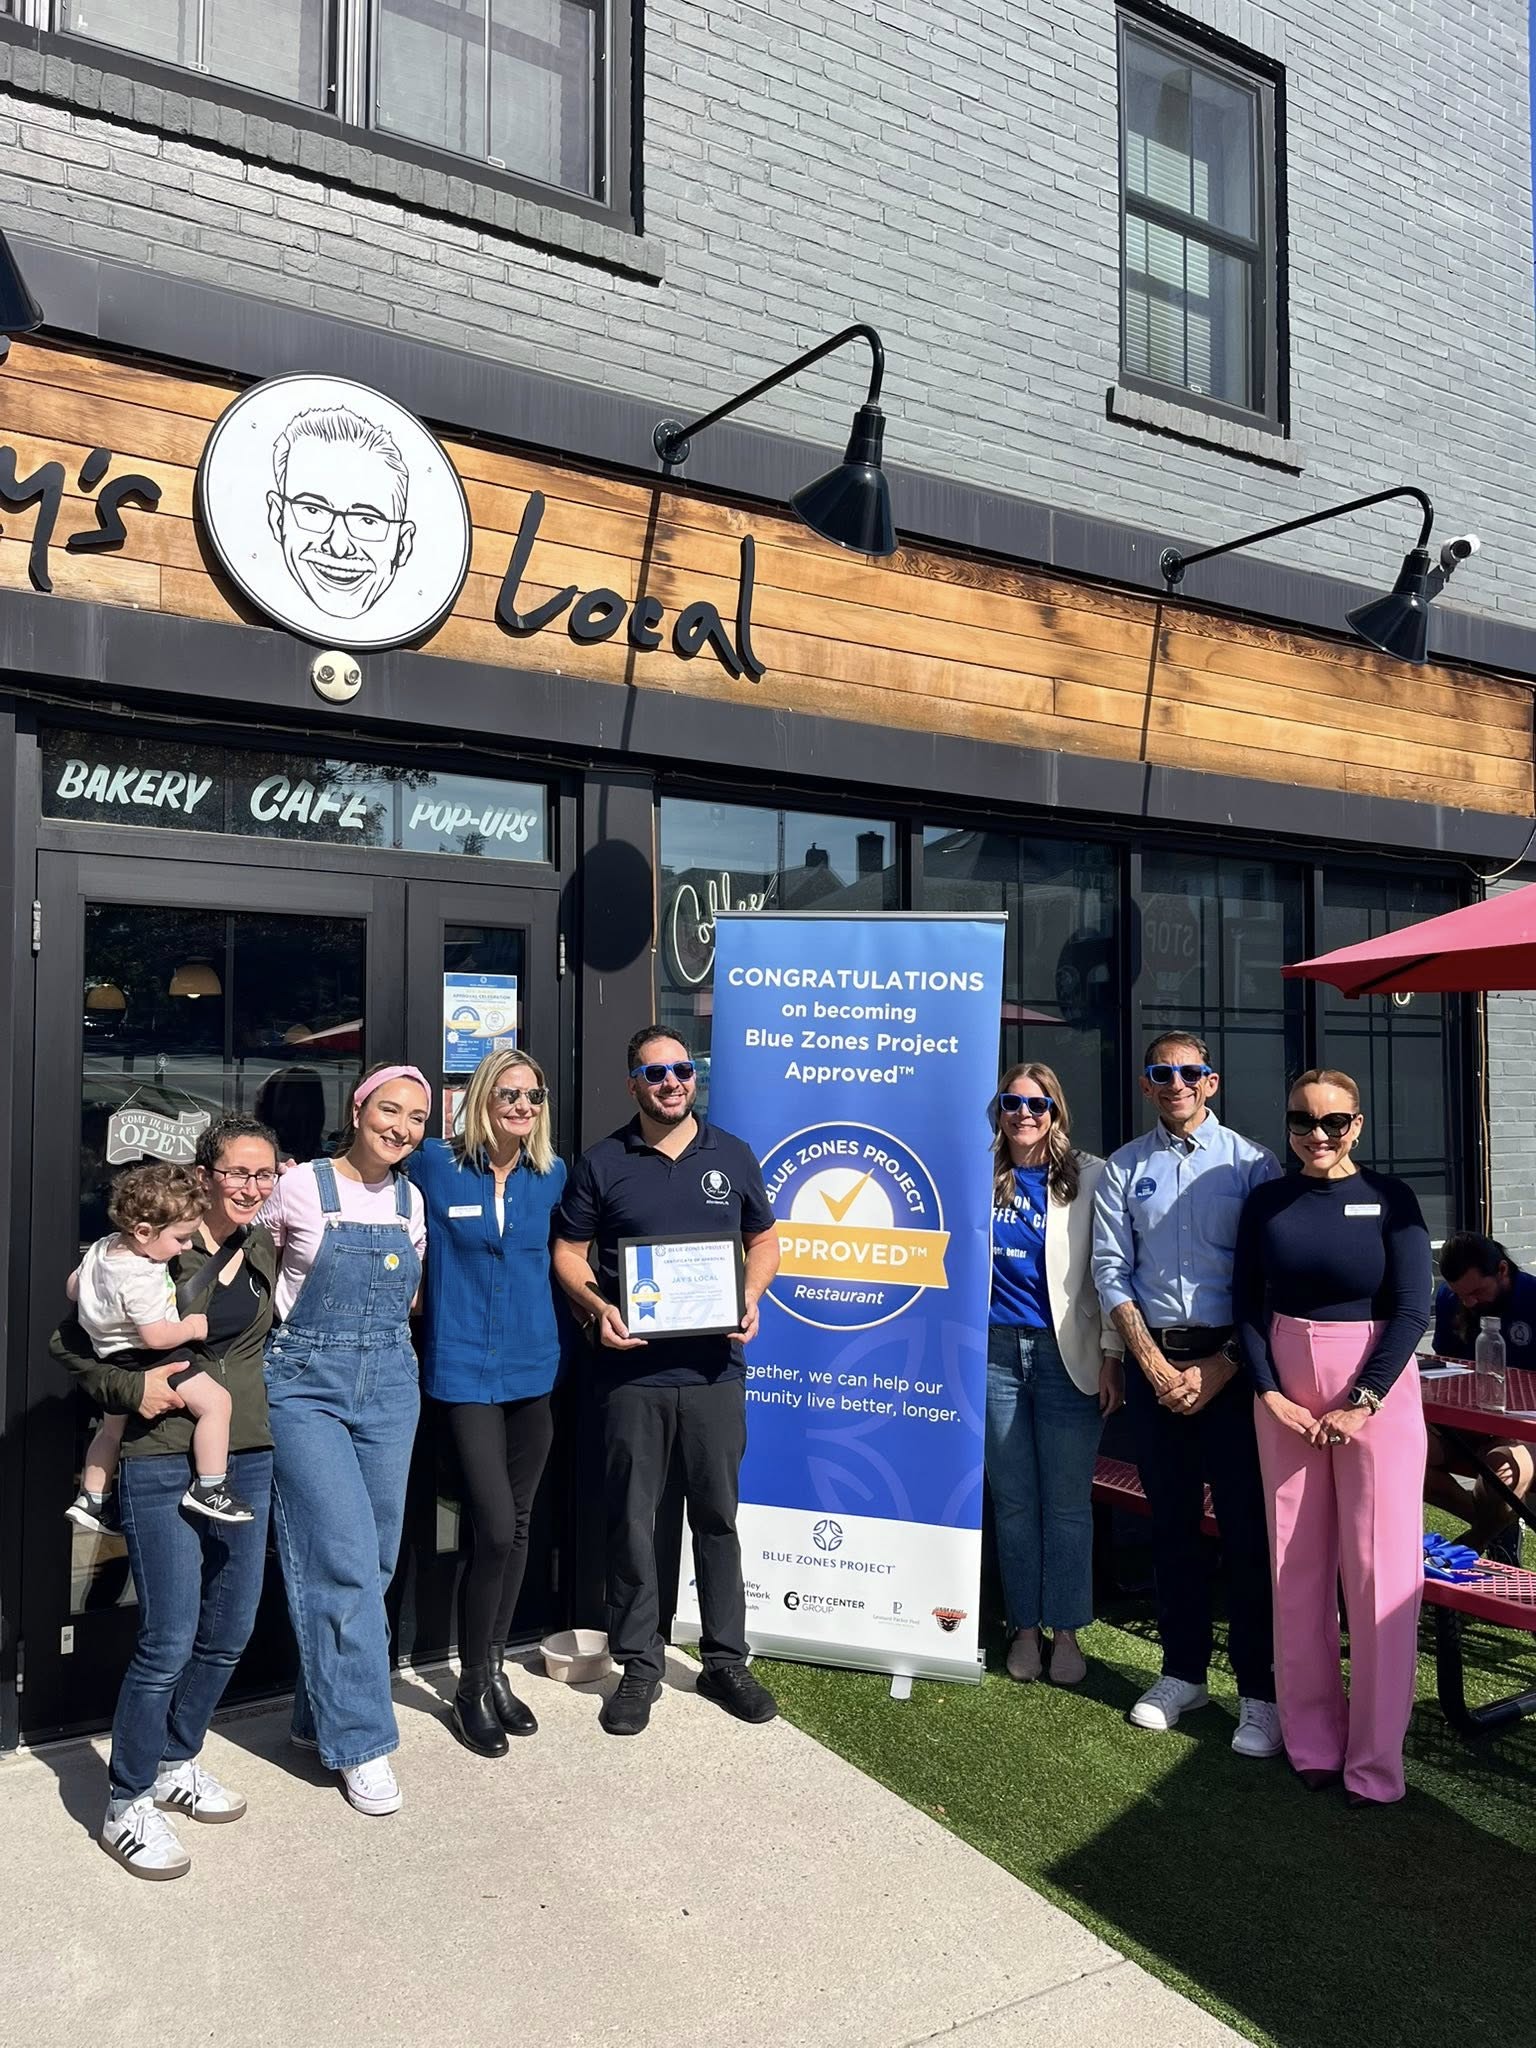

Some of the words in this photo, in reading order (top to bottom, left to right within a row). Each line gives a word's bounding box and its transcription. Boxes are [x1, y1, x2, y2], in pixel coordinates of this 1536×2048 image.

[0, 445, 162, 591] y's
[497, 490, 766, 682] Local
[56, 759, 212, 814] BAKERY
[250, 774, 367, 829] CAFE
[409, 796, 537, 842] POP-UPS
[728, 967, 984, 991] CONGRATULATIONS
[782, 1004, 807, 1017] on
[813, 1002, 917, 1024] becoming
[745, 1029, 793, 1047] Blue
[801, 1031, 869, 1050] Zones
[877, 1034, 958, 1055] Project
[121, 1115, 147, 1125] COME
[163, 1122, 176, 1133] WE
[179, 1126, 198, 1135] ARE
[119, 1123, 199, 1156] OPEN
[796, 1140, 859, 1165] ZONES
[863, 1144, 925, 1215] PROJECT
[992, 1207, 1018, 1224] FFEE
[778, 1237, 928, 1266] PPROVED™
[794, 1284, 885, 1305] Restaurant
[746, 1364, 803, 1383] gether,
[808, 1371, 832, 1384] we
[838, 1373, 867, 1387] can
[873, 1373, 909, 1393] help
[914, 1381, 943, 1395] our
[745, 1389, 802, 1408] munity
[807, 1392, 835, 1409] live
[841, 1395, 896, 1417] better,
[903, 1401, 961, 1423] longer.
[762, 1550, 793, 1563] BLUE
[796, 1555, 837, 1568] ZONES
[746, 1580, 761, 1591] lley
[746, 1590, 771, 1600] twork
[802, 1594, 824, 1604] CITY
[826, 1597, 865, 1610] CENTER
[802, 1603, 834, 1614] GROUP
